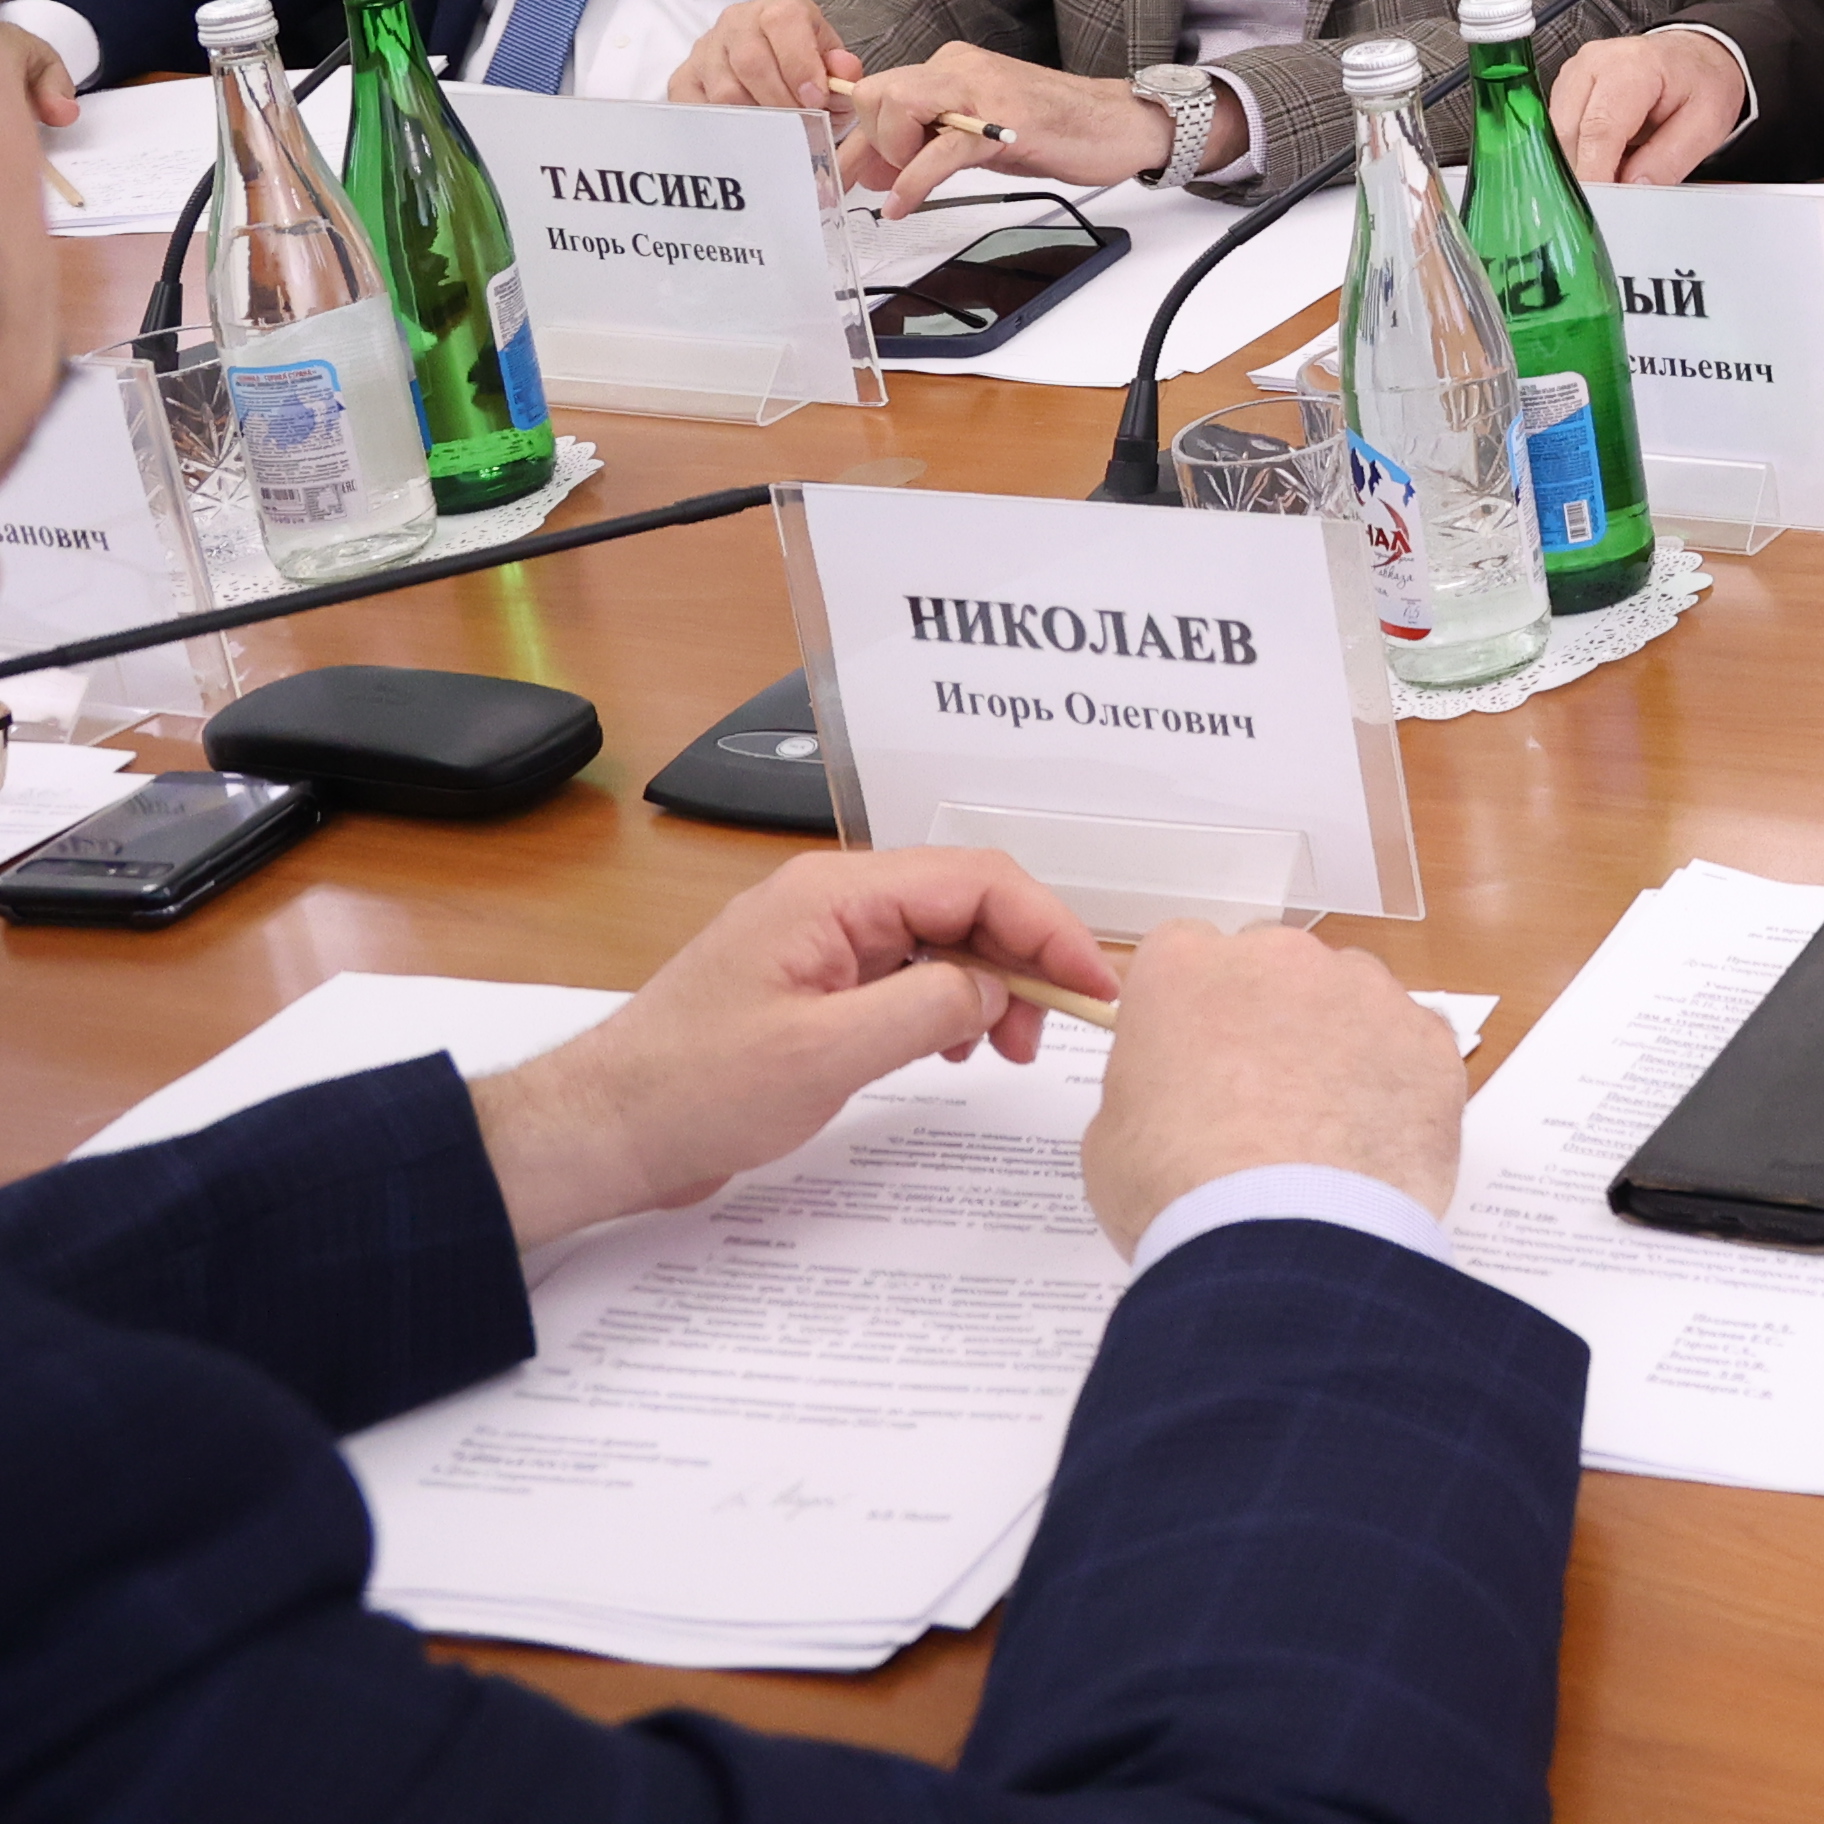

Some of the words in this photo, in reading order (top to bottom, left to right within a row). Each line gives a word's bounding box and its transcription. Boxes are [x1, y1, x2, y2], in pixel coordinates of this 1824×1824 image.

[540, 164, 747, 213] ТАПСИЕВ
[545, 226, 627, 260] Игорь
[634, 232, 767, 267] Сергеевич
[1629, 353, 1776, 384] сильевич
[0, 522, 111, 552] анович
[905, 593, 1258, 667] НИКОЛАЕВ
[933, 679, 1055, 728] Игорь
[1064, 691, 1257, 740] Олегович
